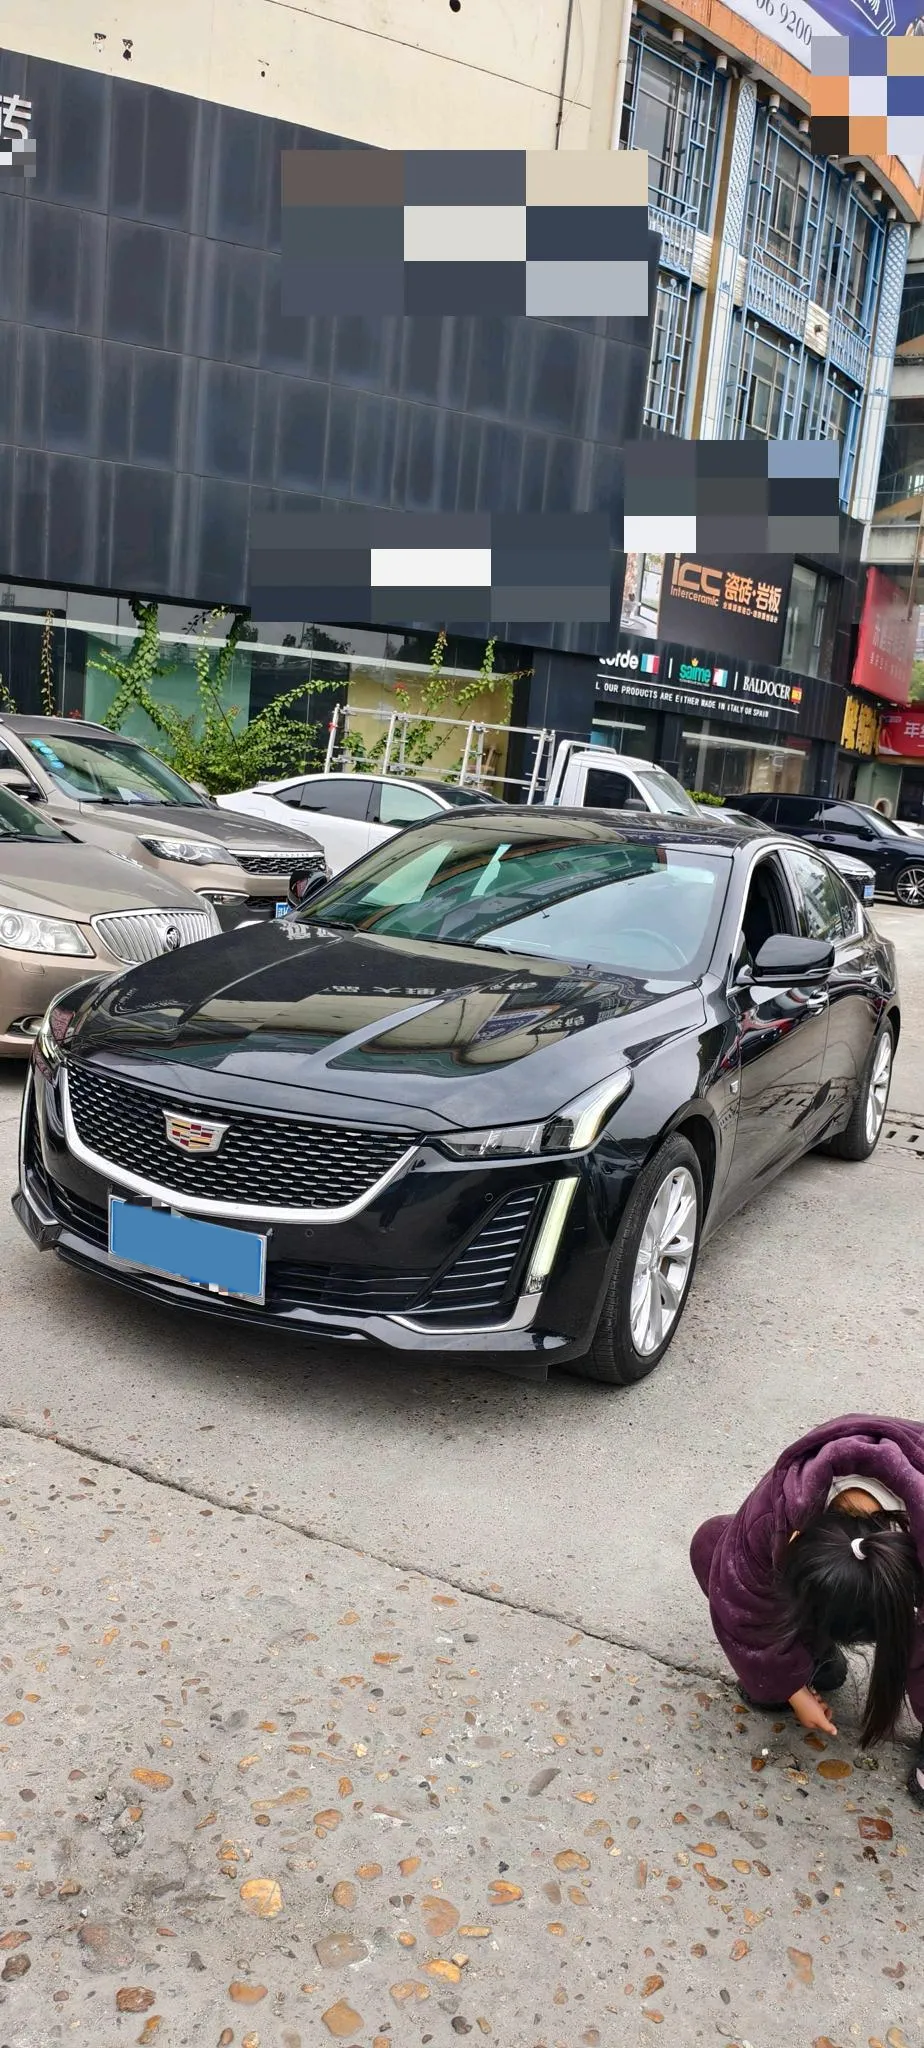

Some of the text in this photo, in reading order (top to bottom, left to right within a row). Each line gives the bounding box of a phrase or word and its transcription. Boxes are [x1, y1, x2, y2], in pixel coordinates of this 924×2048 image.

[780, 3, 812, 46] 9200
[670, 585, 719, 607] Interceramic
[604, 682, 619, 693] OUR
[621, 685, 658, 699] PRODUCTS
[659, 691, 673, 702] ARE
[675, 694, 699, 706] EITHER
[700, 699, 716, 709] MADE
[717, 702, 726, 711] IN
[727, 703, 744, 714] ITALY
[744, 706, 752, 715] OR
[752, 708, 769, 718] SPAIN
[743, 675, 791, 701] BALDOCER
